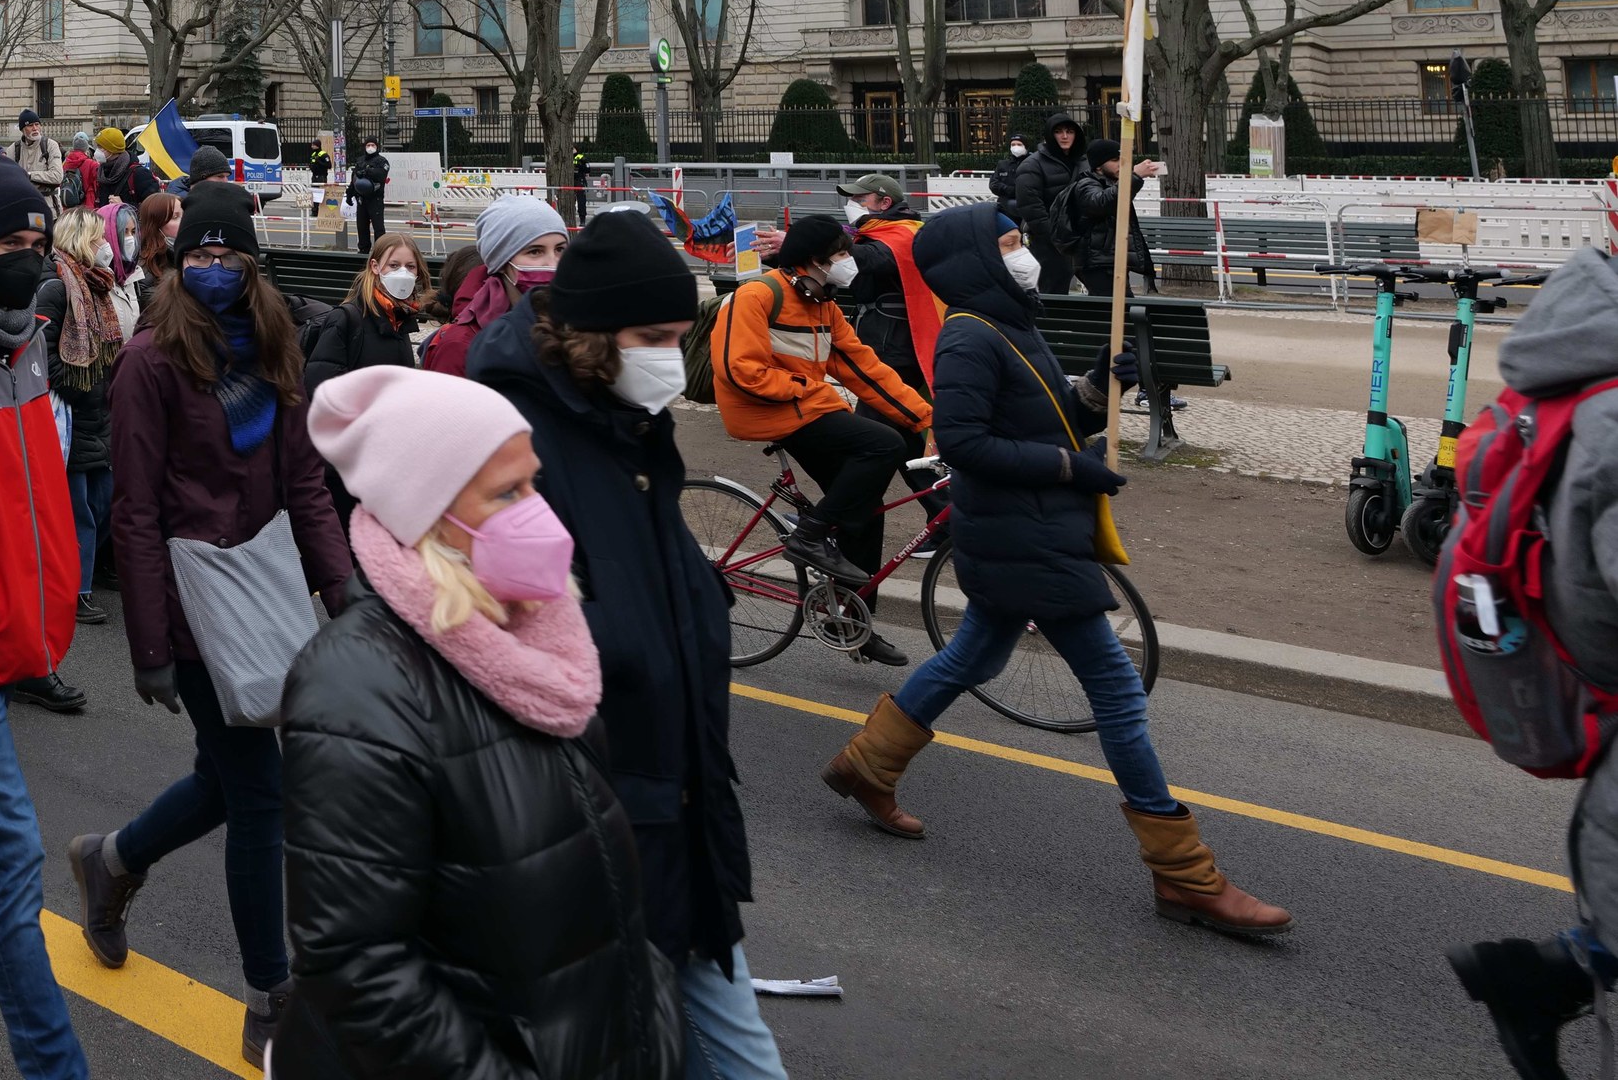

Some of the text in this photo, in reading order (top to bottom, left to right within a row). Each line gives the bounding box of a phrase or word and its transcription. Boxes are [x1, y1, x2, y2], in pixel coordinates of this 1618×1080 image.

[317, 219, 343, 230] UKRAINE
[1370, 359, 1384, 407] TIER
[893, 527, 931, 563] Centurion
